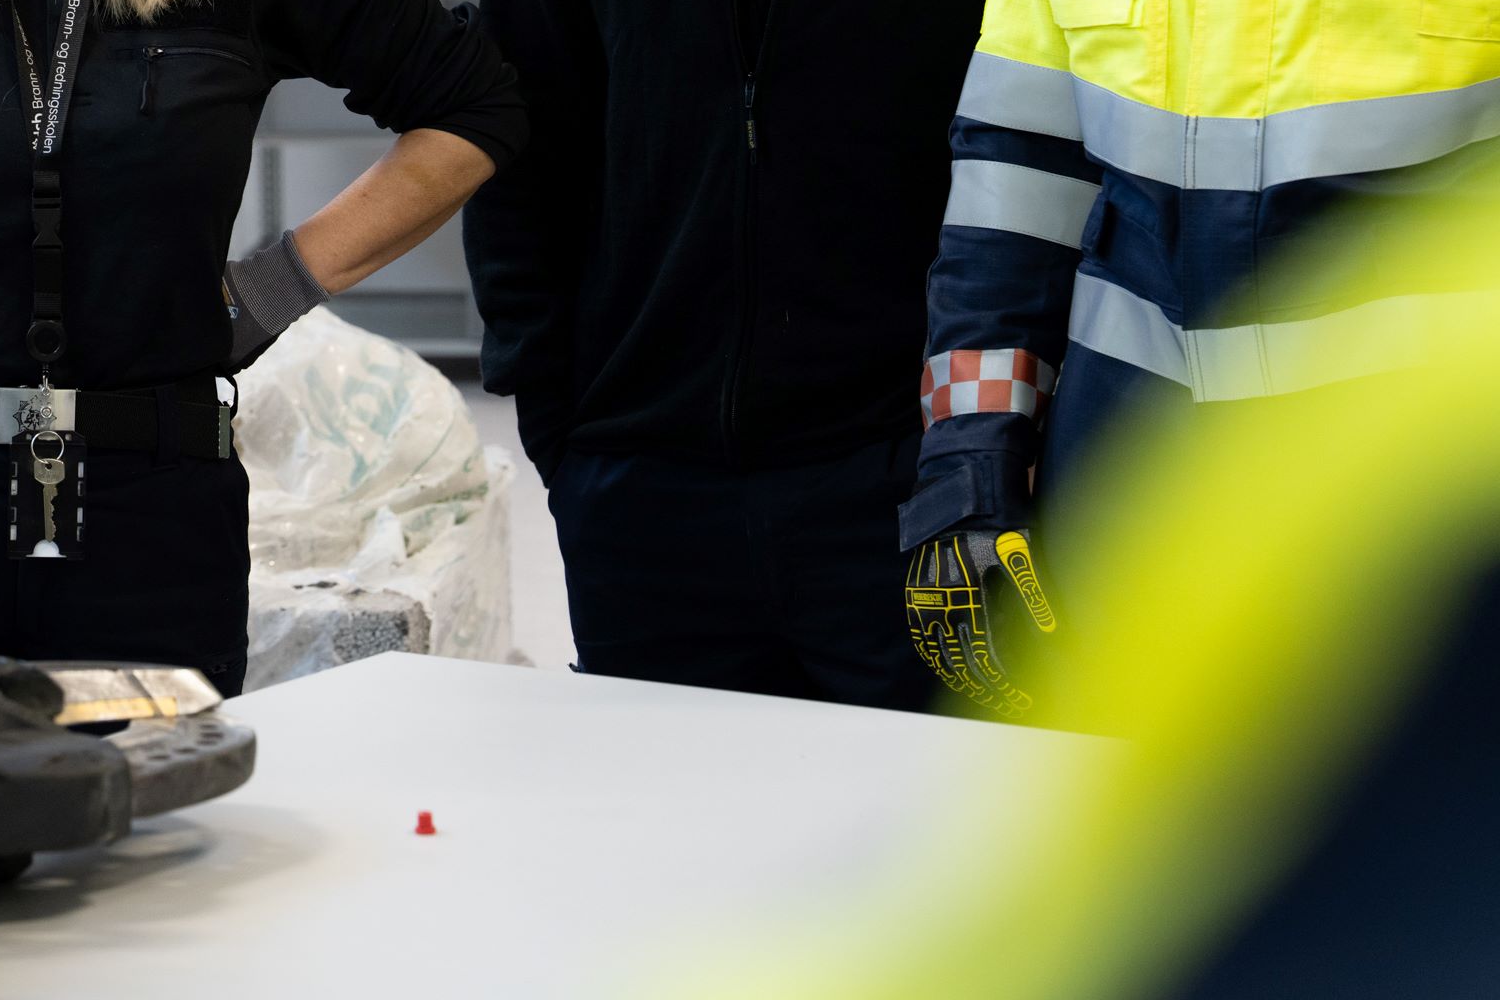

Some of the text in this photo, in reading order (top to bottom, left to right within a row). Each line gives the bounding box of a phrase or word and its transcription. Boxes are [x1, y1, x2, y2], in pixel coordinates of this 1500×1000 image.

[56, 42, 70, 59] og
[29, 68, 44, 109] Brann-
[43, 61, 67, 154] redningsskolen
